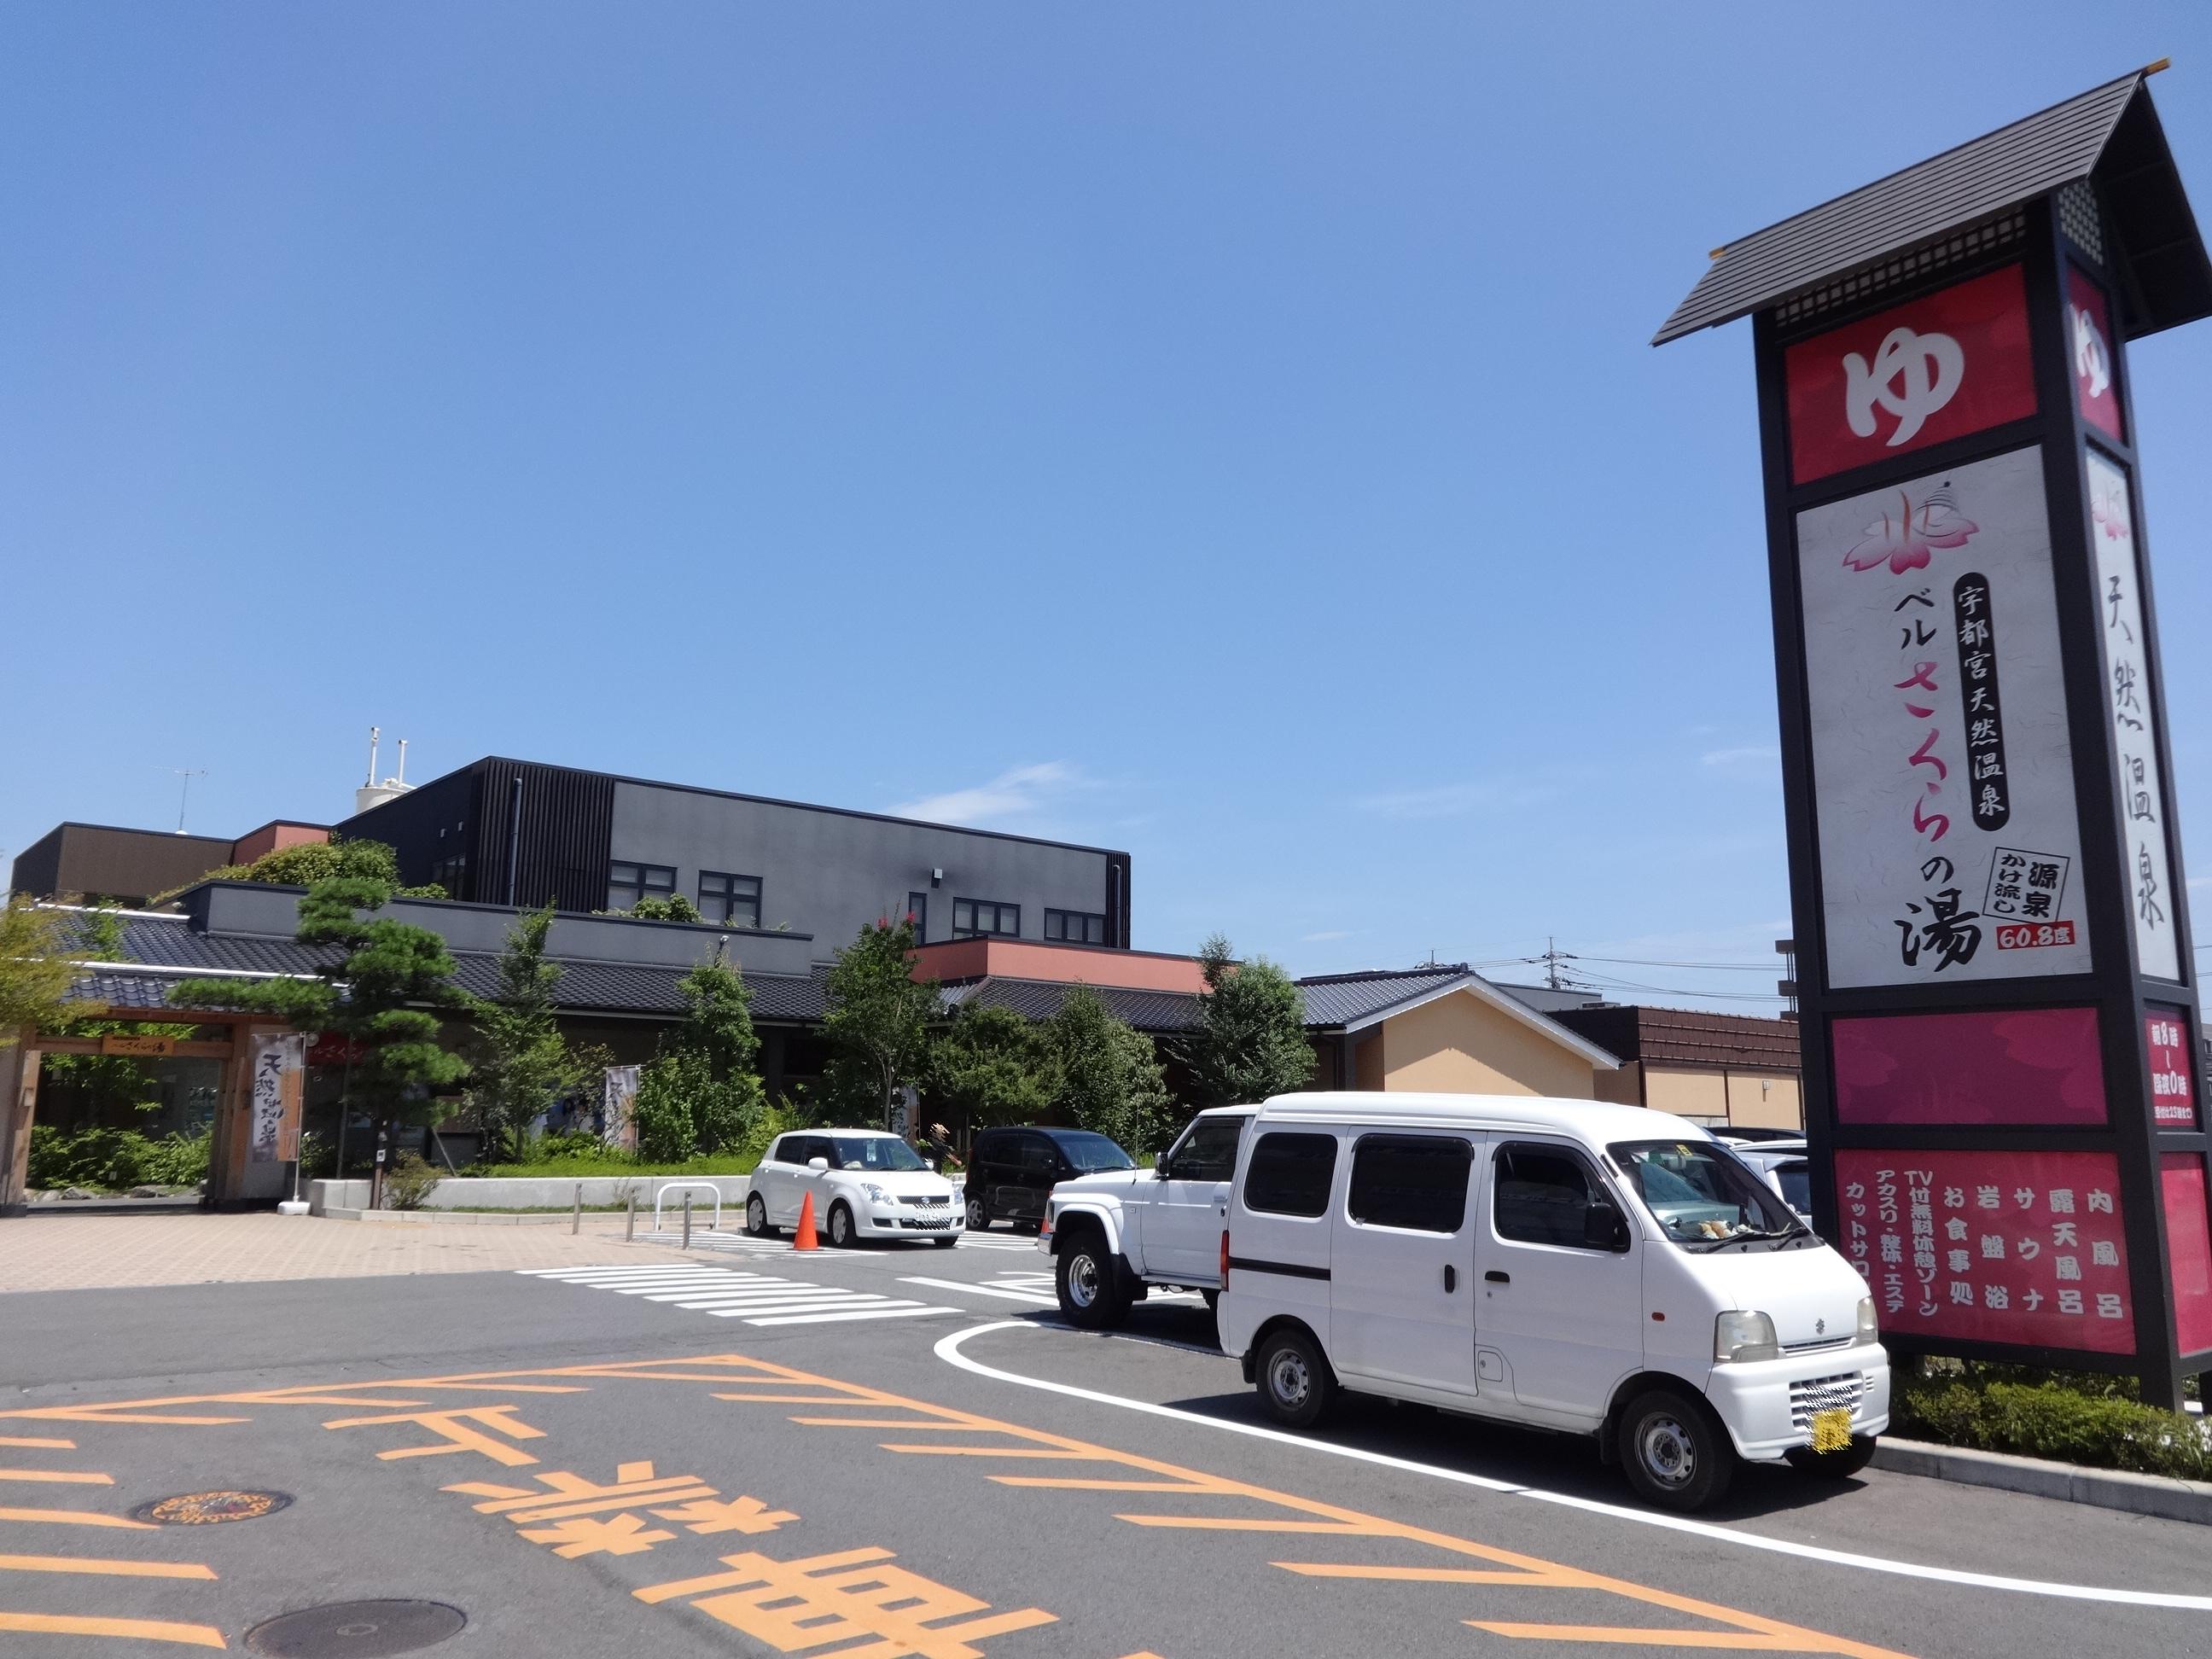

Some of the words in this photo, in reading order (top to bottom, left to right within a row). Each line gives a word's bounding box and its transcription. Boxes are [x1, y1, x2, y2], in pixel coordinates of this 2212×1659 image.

[1842, 327, 1965, 446] ゆ
[2069, 303, 2110, 398] ゆ
[1959, 586, 2005, 817] 宇都宮天然温泉
[2108, 575, 2165, 930] 天然温泉
[1894, 588, 1982, 972] ベルさくらの湯
[1994, 853, 2026, 913] かけ流し
[2000, 926, 2071, 948] 60.8度
[2021, 862, 2059, 917] 源泉
[254, 1053, 284, 1144] 天然温泉
[1846, 1182, 1871, 1289] カットサロ
[1944, 1186, 1973, 1306] お食事処
[1977, 1185, 2008, 1309] 岩盤浴
[2014, 1187, 2044, 1311] サウナ
[2049, 1189, 2083, 1314] 露天風呂
[2087, 1188, 2122, 1318] 内風呂
